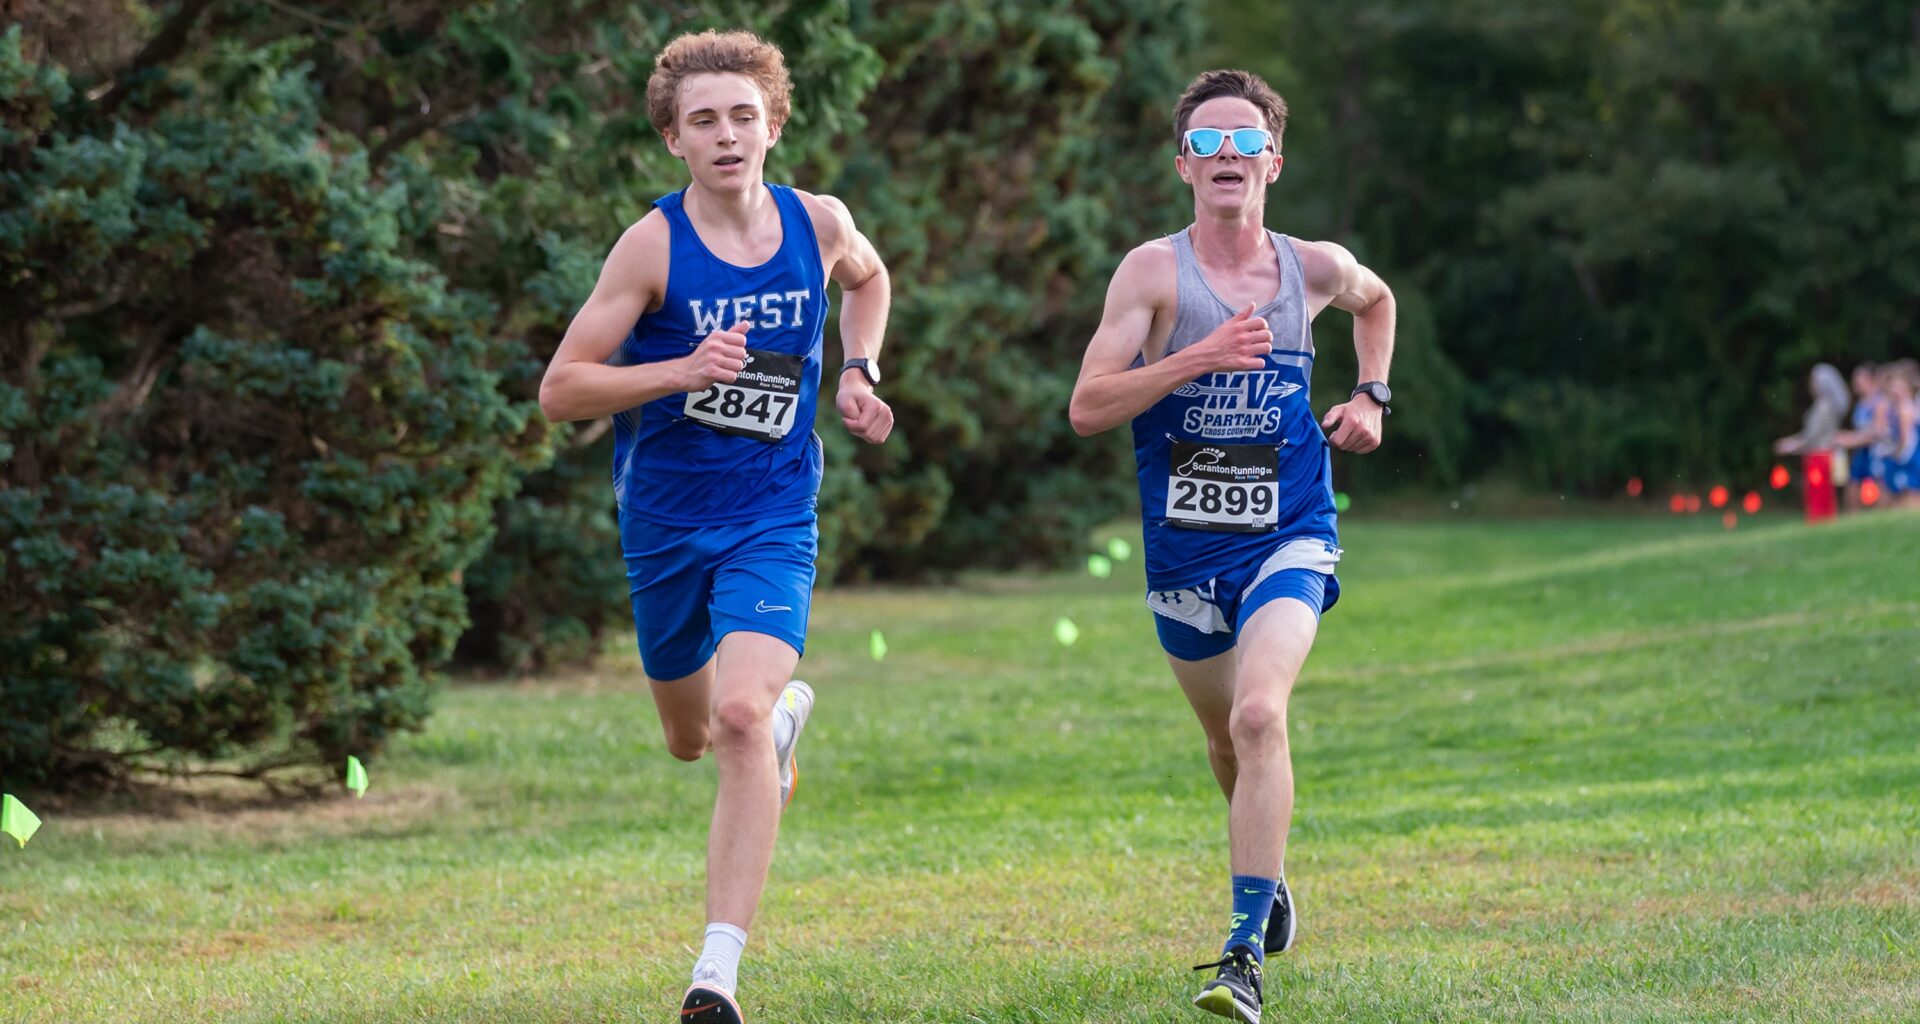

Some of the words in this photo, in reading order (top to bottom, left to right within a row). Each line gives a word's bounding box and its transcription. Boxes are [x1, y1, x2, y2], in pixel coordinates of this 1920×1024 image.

[689, 289, 810, 336] WEST
[692, 386, 794, 426] 2847
[1204, 427, 1225, 436] CROSS
[1227, 427, 1256, 436] COUNTRY
[1173, 480, 1273, 515] 2899
